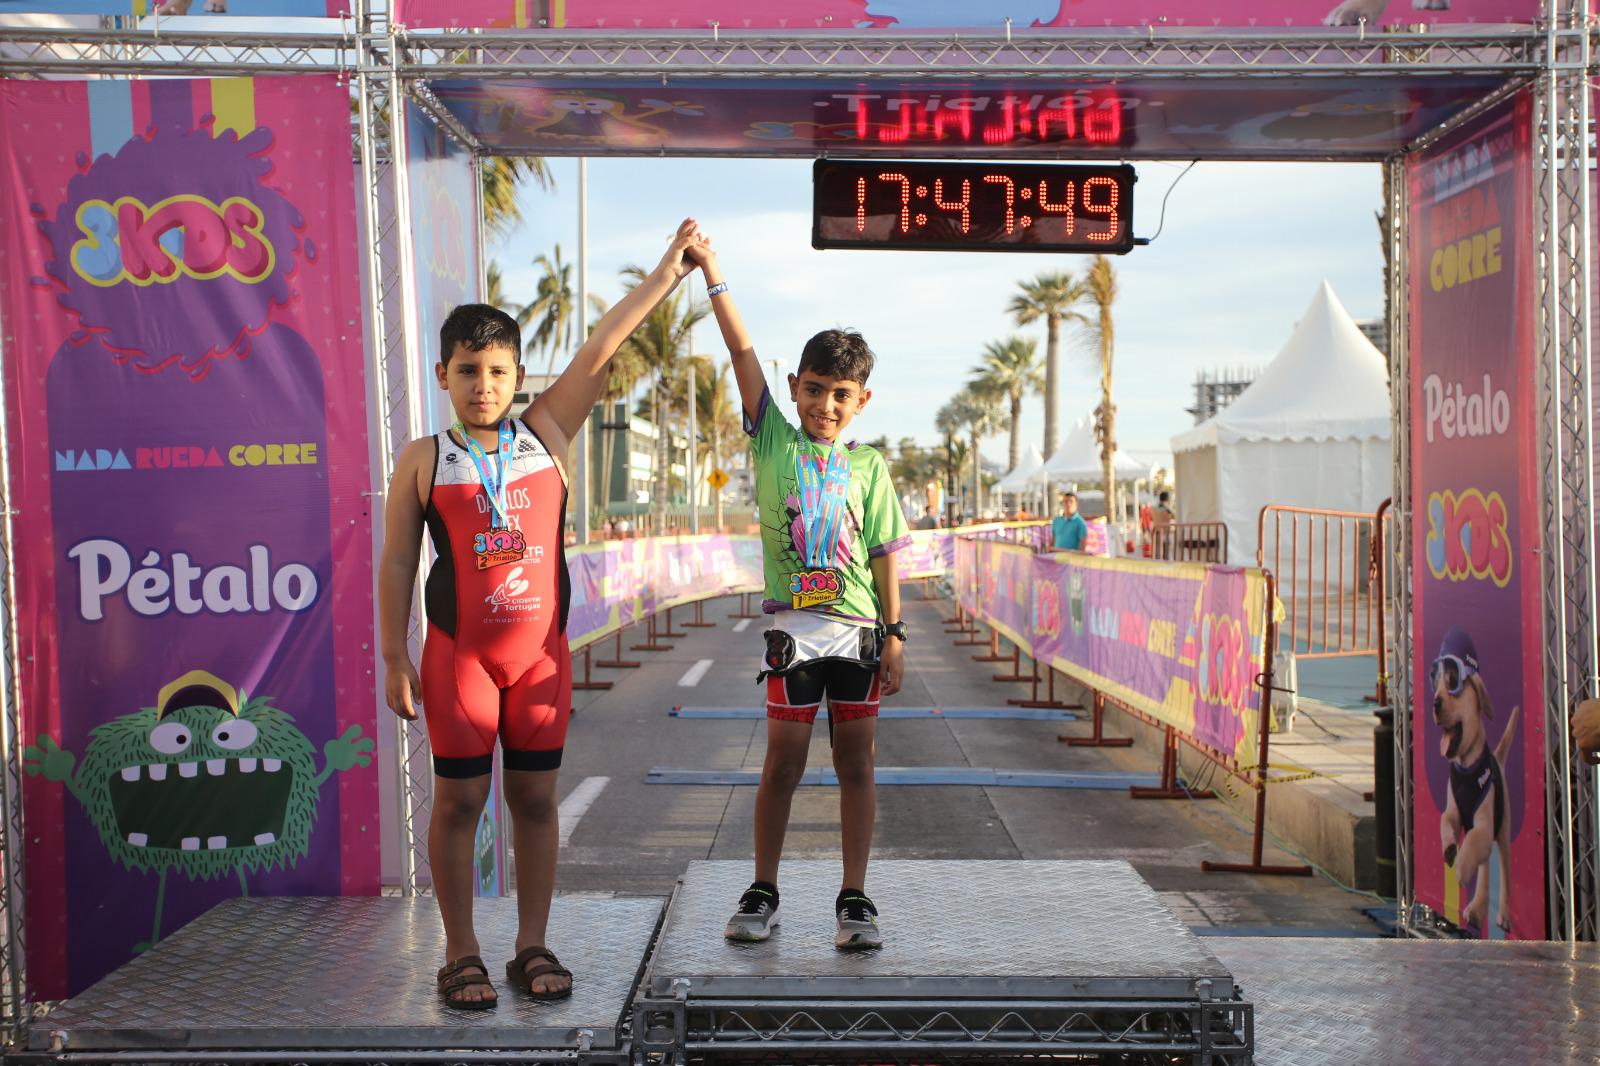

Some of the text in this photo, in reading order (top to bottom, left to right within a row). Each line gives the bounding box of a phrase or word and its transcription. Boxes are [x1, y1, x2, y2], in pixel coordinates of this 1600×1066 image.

[856, 172, 1120, 241] 17:47:49
[1429, 226, 1502, 293] CORRE
[1423, 373, 1510, 444] Pétalo
[55, 442, 318, 472] NADA RUEDA CORRE
[475, 487, 531, 514] DALOS
[68, 538, 319, 621] Pétalo
